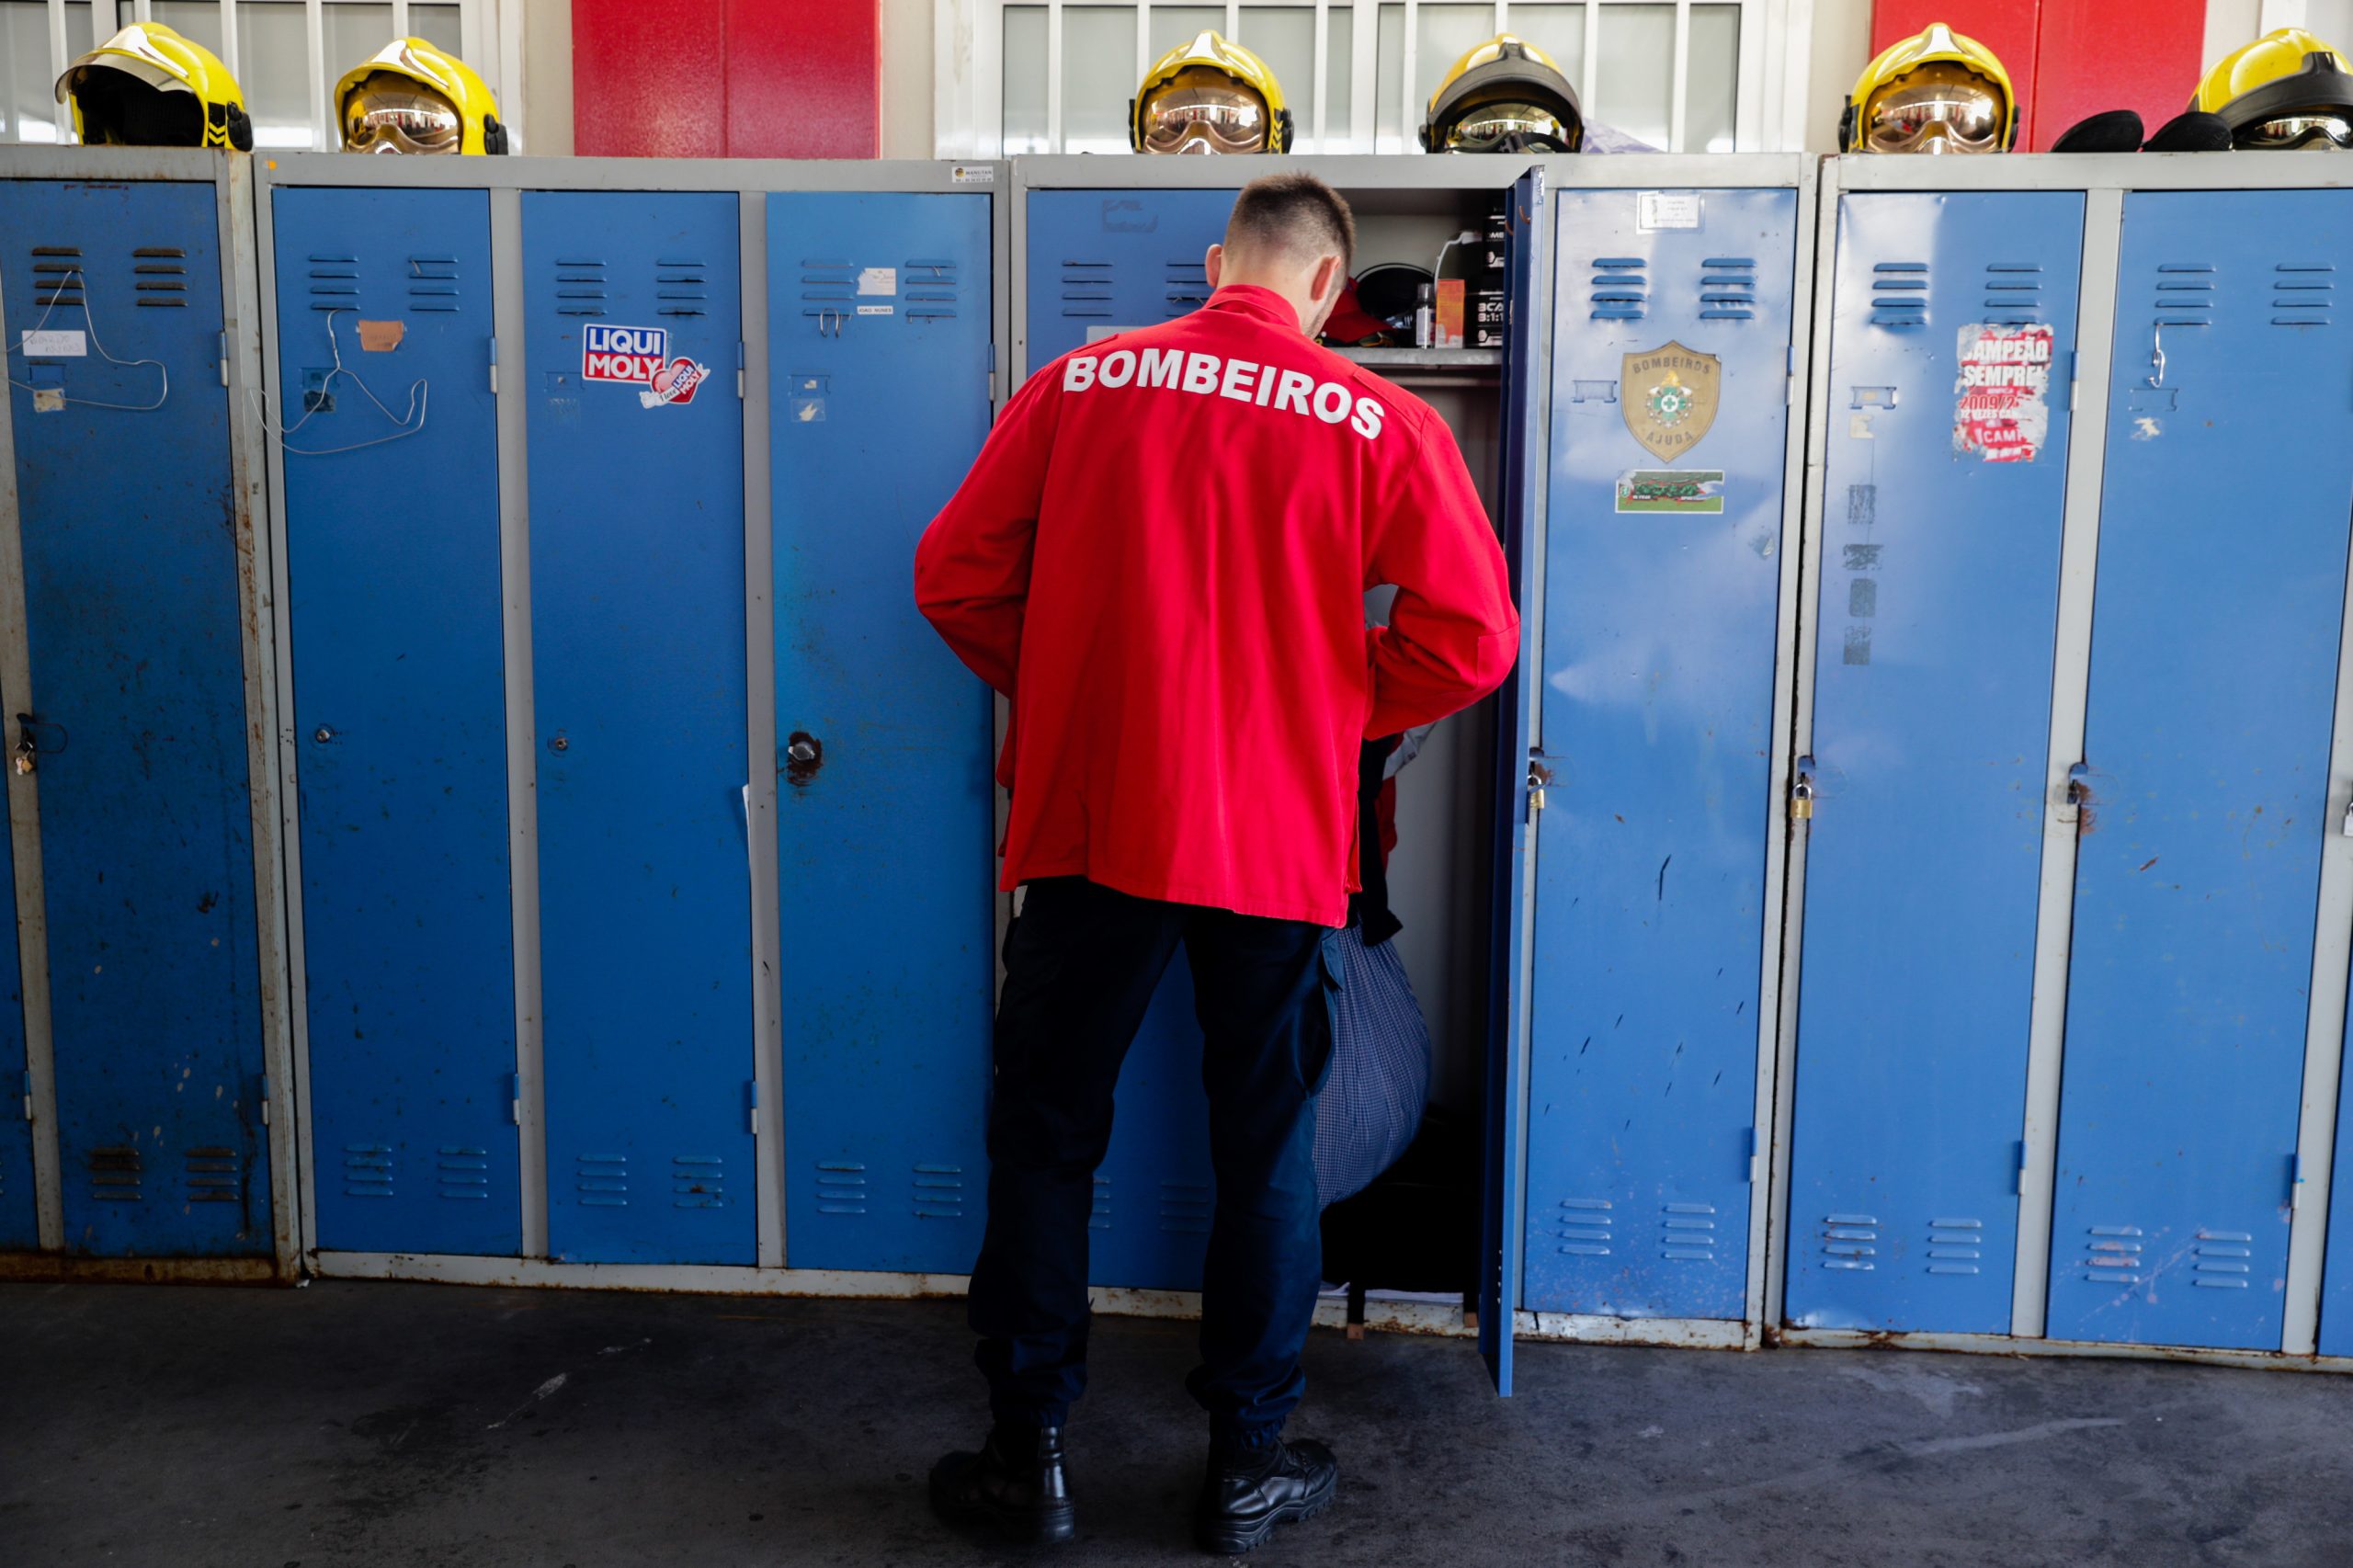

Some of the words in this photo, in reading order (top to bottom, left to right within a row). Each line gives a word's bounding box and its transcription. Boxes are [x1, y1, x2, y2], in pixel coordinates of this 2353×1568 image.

[589, 328, 661, 355] LIQUI
[1964, 336, 2050, 363] AMPEÃO
[587, 353, 663, 380] MOLY
[673, 365, 694, 388] LIQUI
[1632, 357, 1711, 374] BOMBEIROS
[679, 370, 700, 394] MOLY
[1063, 347, 1385, 440] BOMBEIROS
[1646, 431, 1692, 445] AJUDA
